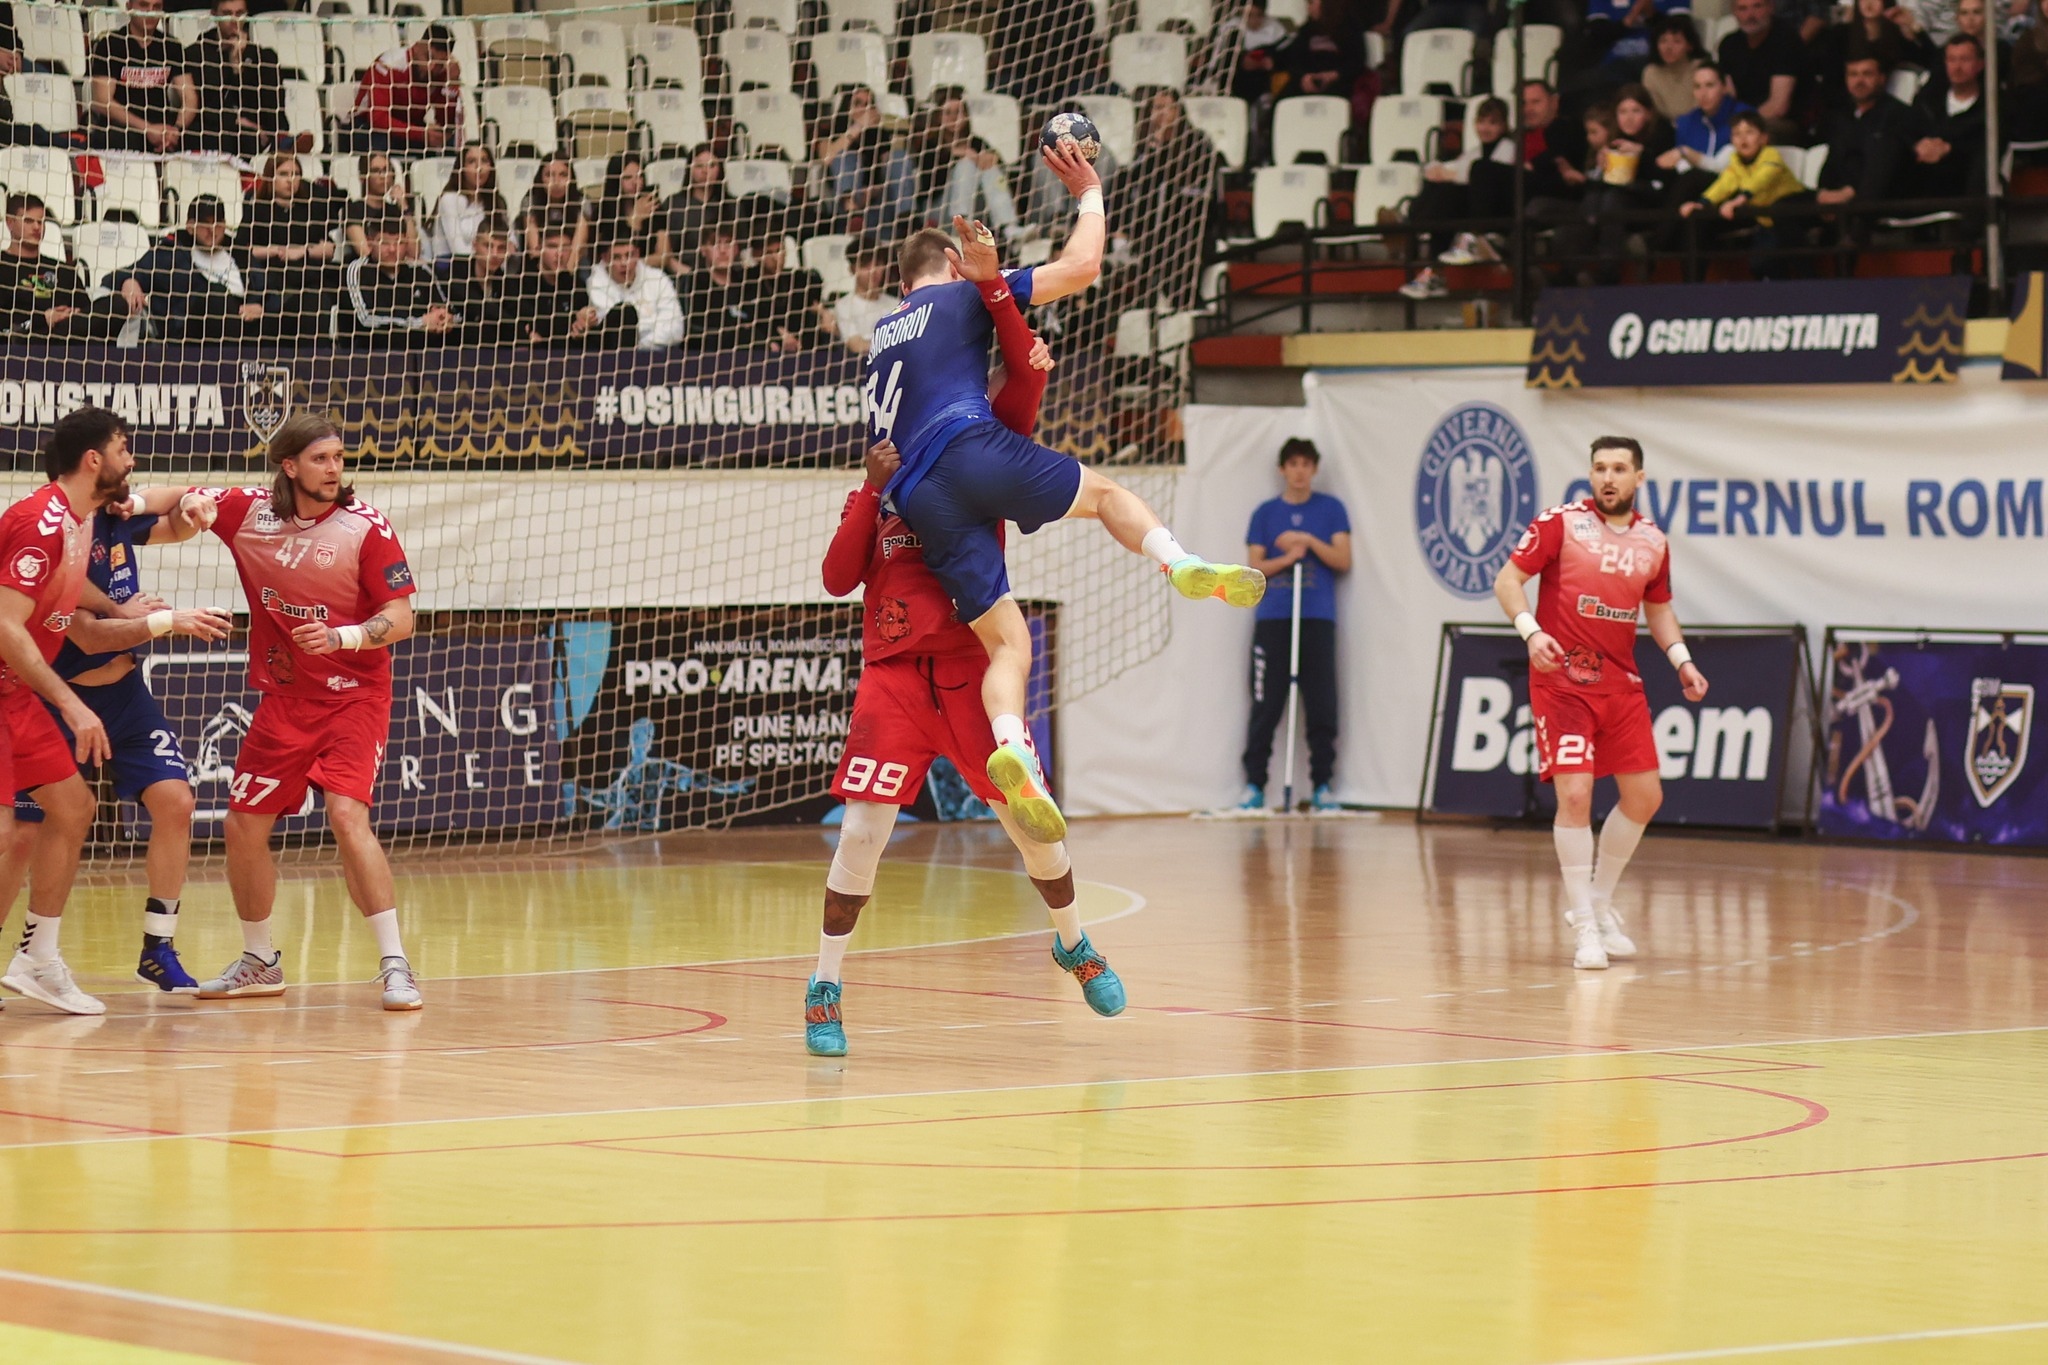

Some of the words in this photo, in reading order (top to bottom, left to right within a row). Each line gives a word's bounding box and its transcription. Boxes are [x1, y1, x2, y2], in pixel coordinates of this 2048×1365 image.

[1646, 318, 1712, 354] CSM
[1713, 313, 1879, 357] CONSTANȚA
[595, 385, 868, 425] #OSINGURAEC
[1423, 410, 1530, 478] GUVERNUL
[1908, 478, 2044, 538] ROM
[275, 536, 312, 570] 47
[1600, 543, 1634, 577] 24
[625, 659, 708, 696] PRO
[718, 656, 843, 696] ARENA
[733, 715, 793, 740] PUNE
[796, 708, 851, 739] MÂN
[715, 745, 746, 768] PE
[749, 742, 845, 766] SPECTAC
[229, 772, 281, 807] 47
[841, 756, 909, 797] 99
